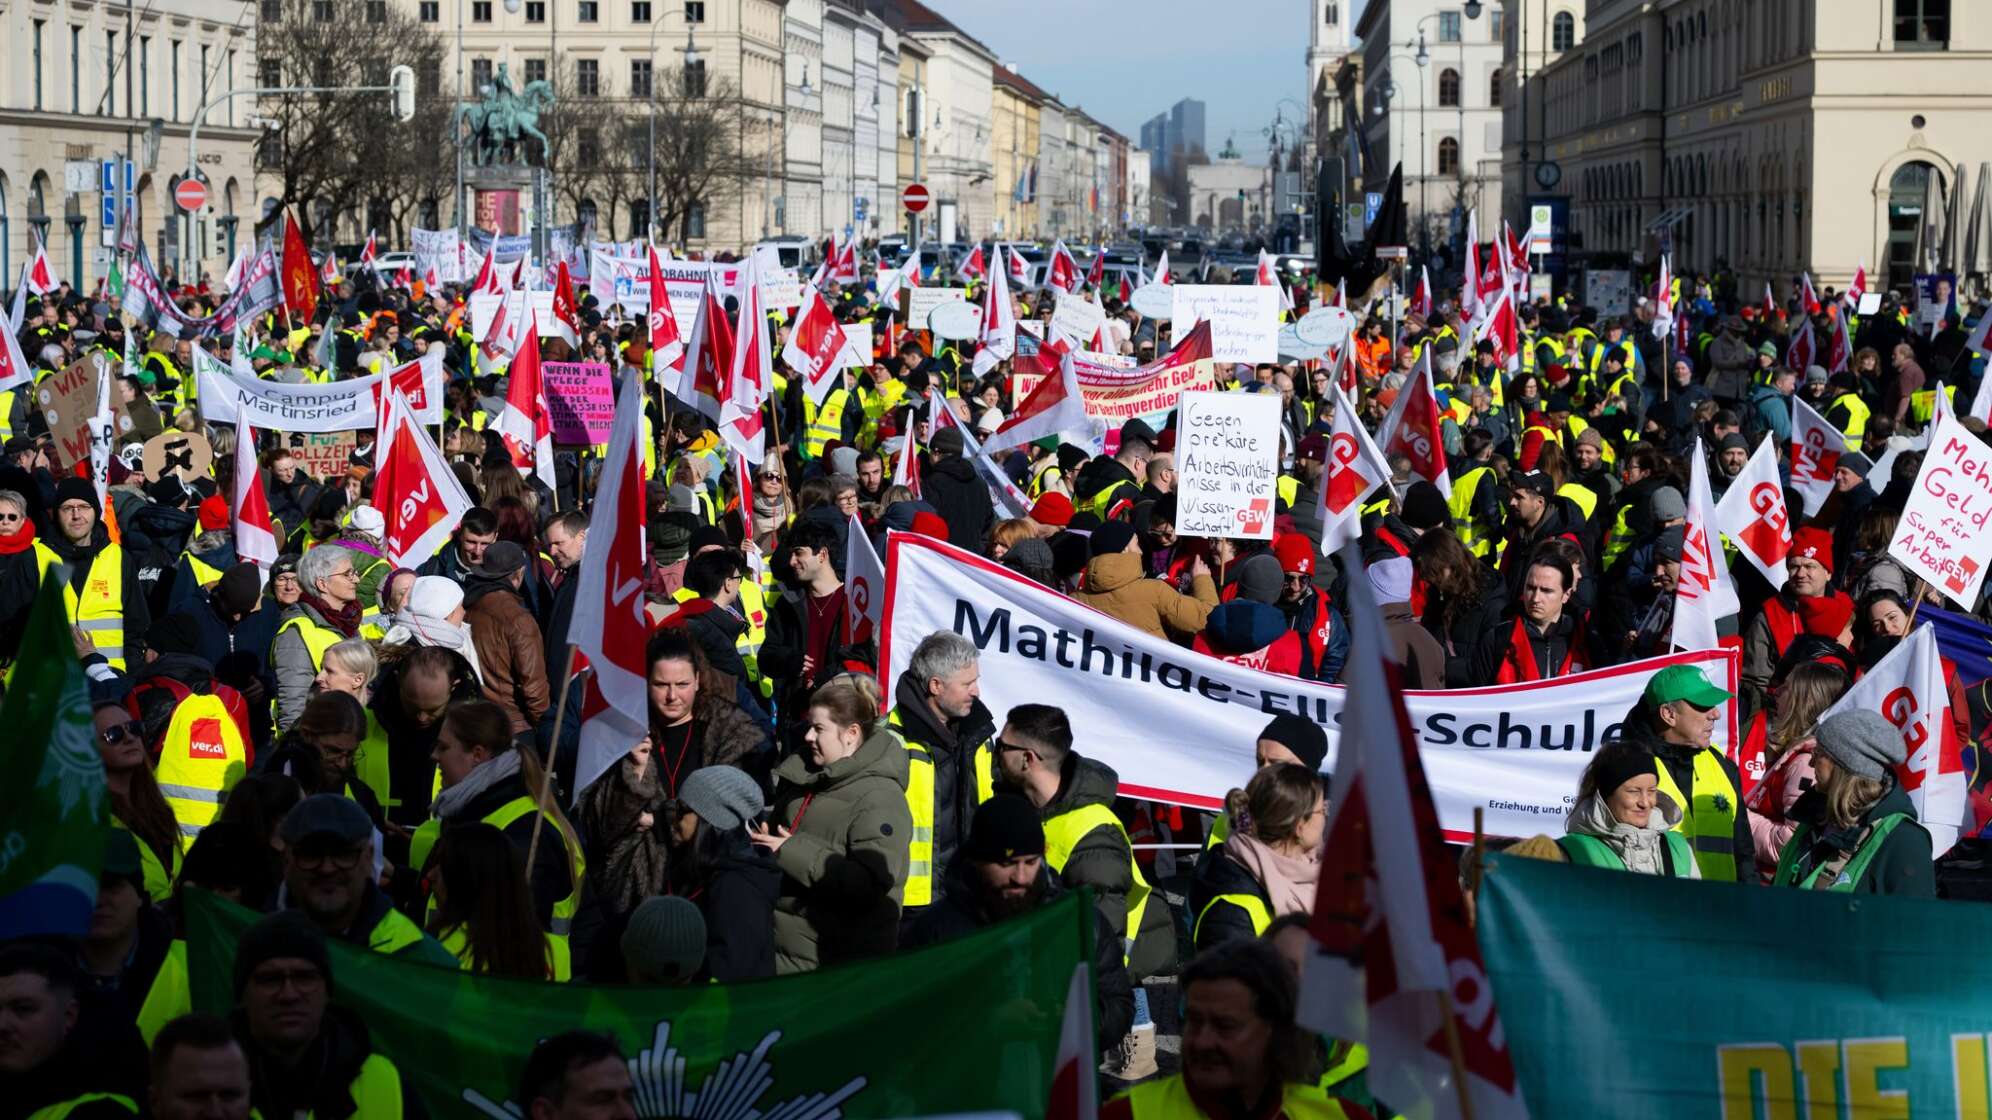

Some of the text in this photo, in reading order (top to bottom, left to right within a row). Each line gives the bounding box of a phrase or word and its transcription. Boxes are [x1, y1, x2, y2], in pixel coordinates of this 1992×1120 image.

[545, 365, 603, 377] WENN DIE
[547, 376, 588, 386] PFLEGE
[54, 366, 88, 397] WIR
[238, 389, 357, 419] Martinsried
[264, 387, 357, 407] Campus
[598, 404, 614, 412] IST
[1188, 402, 1241, 433] Gegen
[1186, 478, 1269, 495] nisse in der
[1924, 467, 1992, 532] Geld
[1236, 509, 1270, 523] GEW
[1906, 511, 1952, 551] Super
[1940, 516, 1971, 540] für
[953, 598, 1624, 752] Mathilde-Ell-Schule
[191, 741, 224, 753] ver.di
[1489, 800, 1540, 814] Erziehung
[1542, 806, 1561, 815] und
